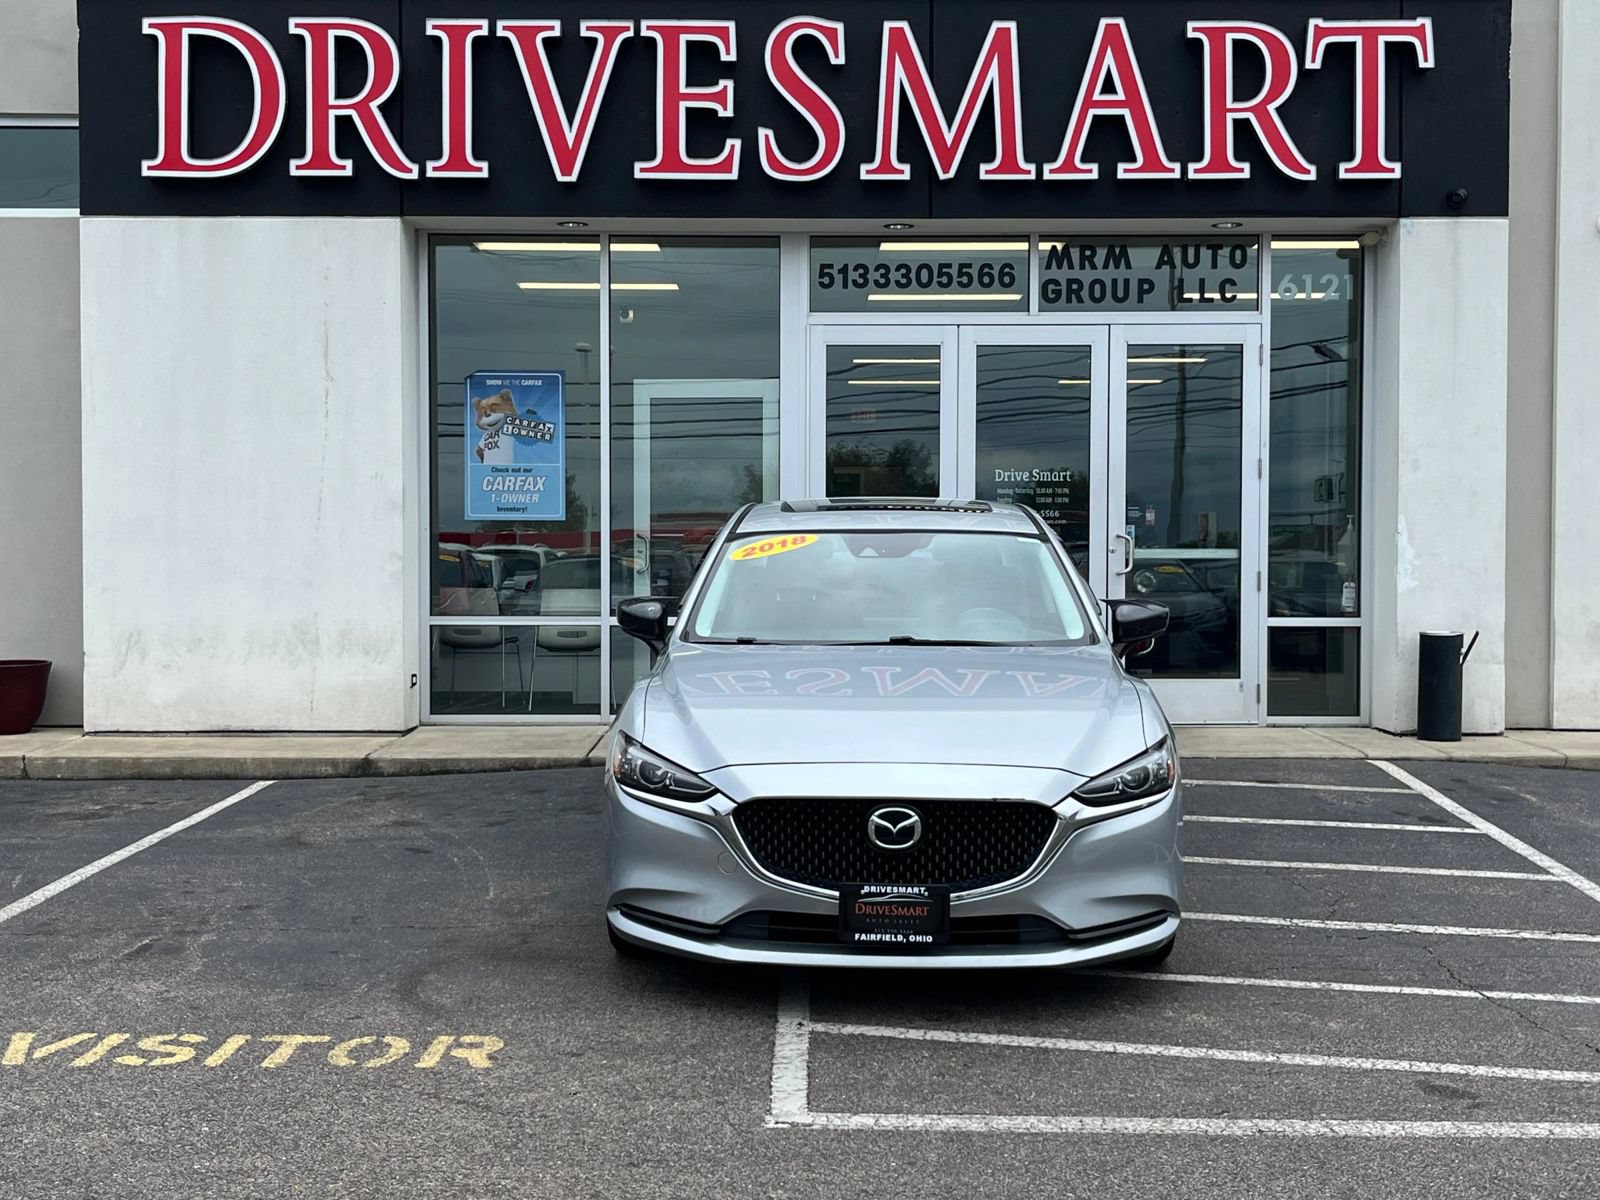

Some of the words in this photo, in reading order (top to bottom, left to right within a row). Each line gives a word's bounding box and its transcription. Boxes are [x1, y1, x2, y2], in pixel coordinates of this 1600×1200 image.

[141, 16, 1435, 183] DRIVESMART
[1044, 244, 1132, 271] MRM
[1155, 243, 1248, 270] AUTO
[818, 263, 1016, 290] 5133305566
[1041, 277, 1156, 304] GROUP
[1177, 277, 1238, 304] LLC
[1277, 273, 1354, 301] 6121
[505, 416, 555, 434] CARFAX
[512, 427, 552, 441] OWNER
[484, 440, 500, 451] FOX
[482, 476, 547, 492] CARFAX
[995, 468, 1030, 482] Drive
[1032, 468, 1072, 482] Smart
[496, 506, 528, 514] Inventory!
[742, 535, 807, 558] 2018
[864, 885, 926, 894] DRIVESMART
[855, 933, 907, 943] FAIRFIELD,
[909, 934, 933, 943] OHIO
[1, 1032, 505, 1069] VISITOR
